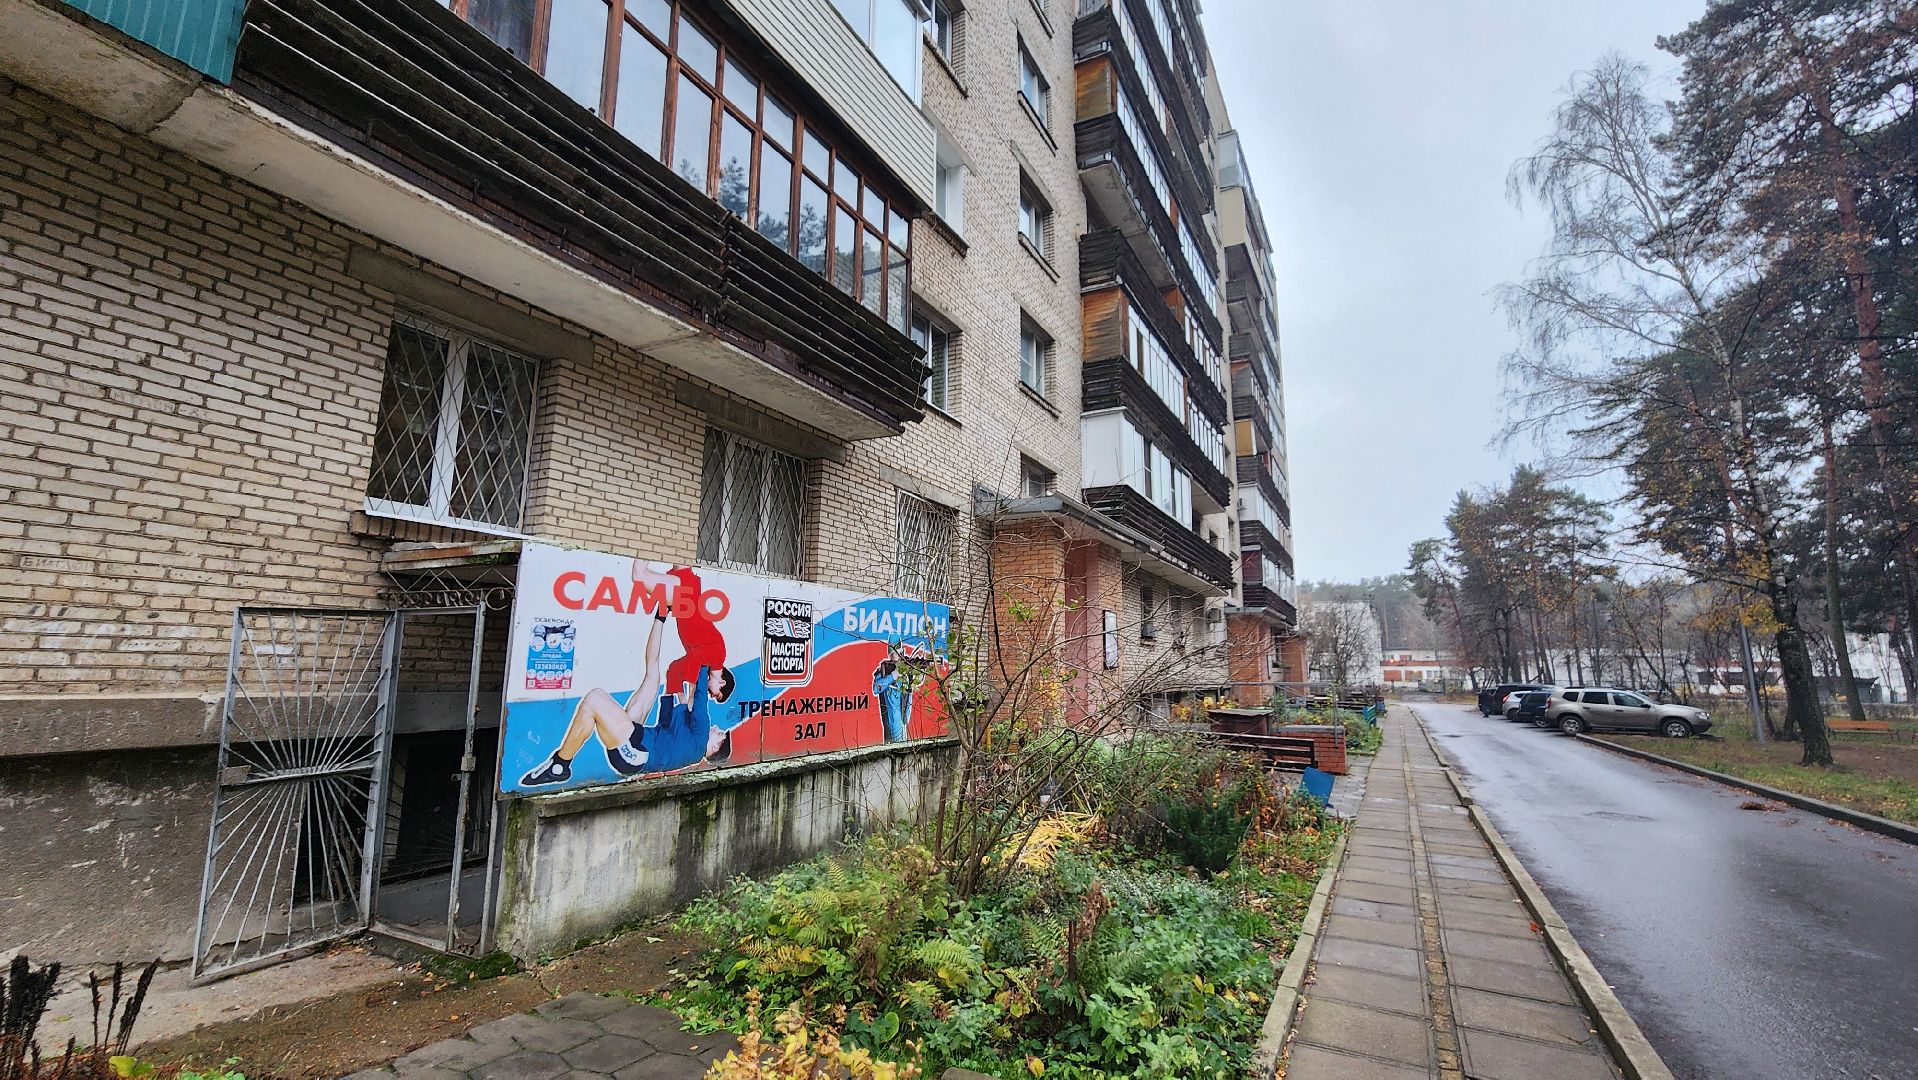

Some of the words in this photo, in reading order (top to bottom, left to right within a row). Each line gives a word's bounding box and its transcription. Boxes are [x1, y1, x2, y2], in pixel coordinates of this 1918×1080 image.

[553, 571, 731, 622] САМБО
[767, 601, 811, 617] РОССИЯ
[843, 606, 946, 638] БИАТЛОН
[771, 642, 804, 657] МАСТЕР
[771, 657, 804, 671] СПОРТА
[738, 692, 869, 719] ТРЕНАЖЕРНЫЙ
[794, 722, 826, 740] ЗАЛ
